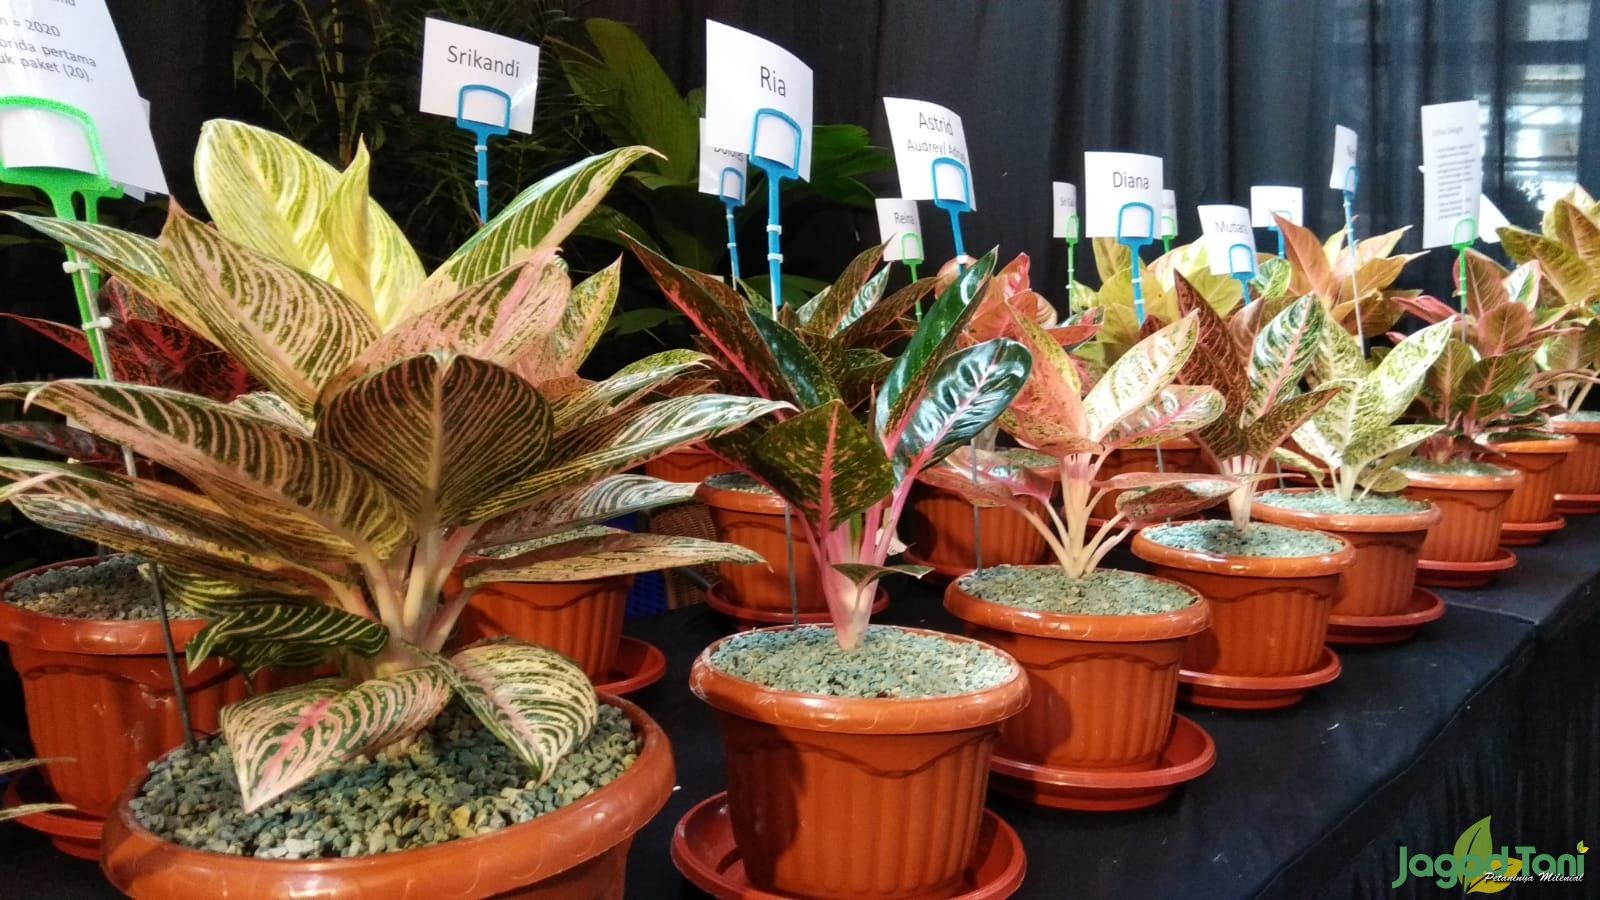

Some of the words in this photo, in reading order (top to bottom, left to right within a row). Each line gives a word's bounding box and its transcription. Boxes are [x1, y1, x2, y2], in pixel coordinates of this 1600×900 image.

[25, 19, 60, 37] 2020
[20, 58, 60, 73] paket
[41, 46, 96, 67] pertama
[447, 45, 520, 78] Srikandi
[760, 65, 787, 98] Ria
[919, 111, 954, 136] Astrid
[1113, 171, 1150, 190] Diana
